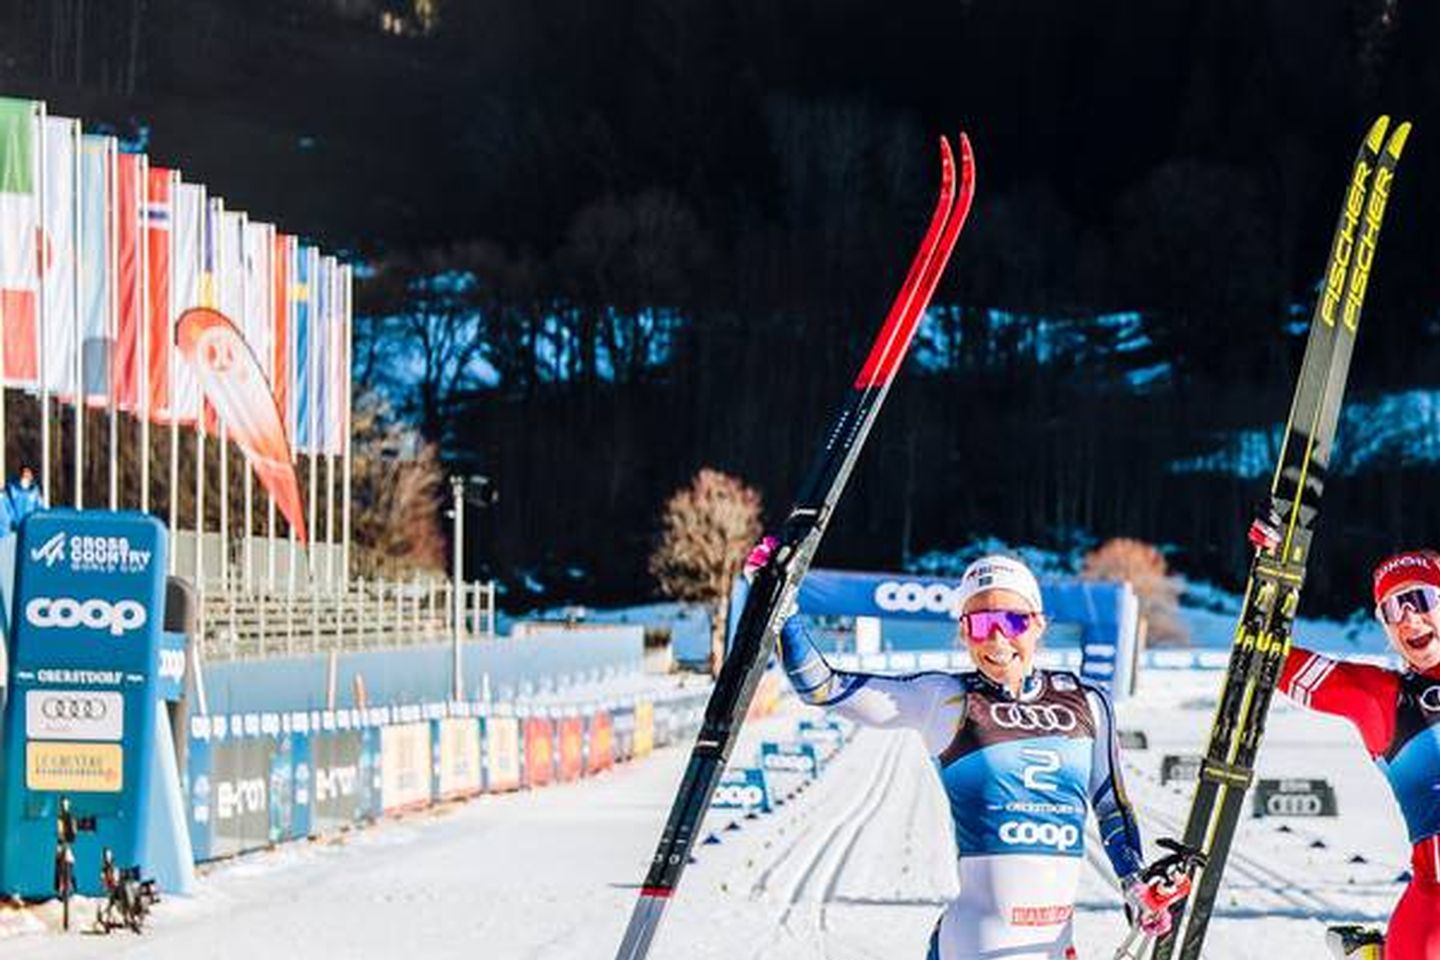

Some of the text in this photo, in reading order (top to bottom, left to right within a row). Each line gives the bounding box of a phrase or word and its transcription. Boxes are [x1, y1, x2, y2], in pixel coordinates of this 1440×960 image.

[1321, 161, 1372, 327] FISCHER
[1343, 166, 1393, 331] FISCHER
[70, 536, 129, 551] CROSS
[70, 549, 151, 566] COUNTRY
[25, 597, 147, 636] coop
[1017, 748, 1061, 791] 2
[998, 820, 1079, 851] coop
